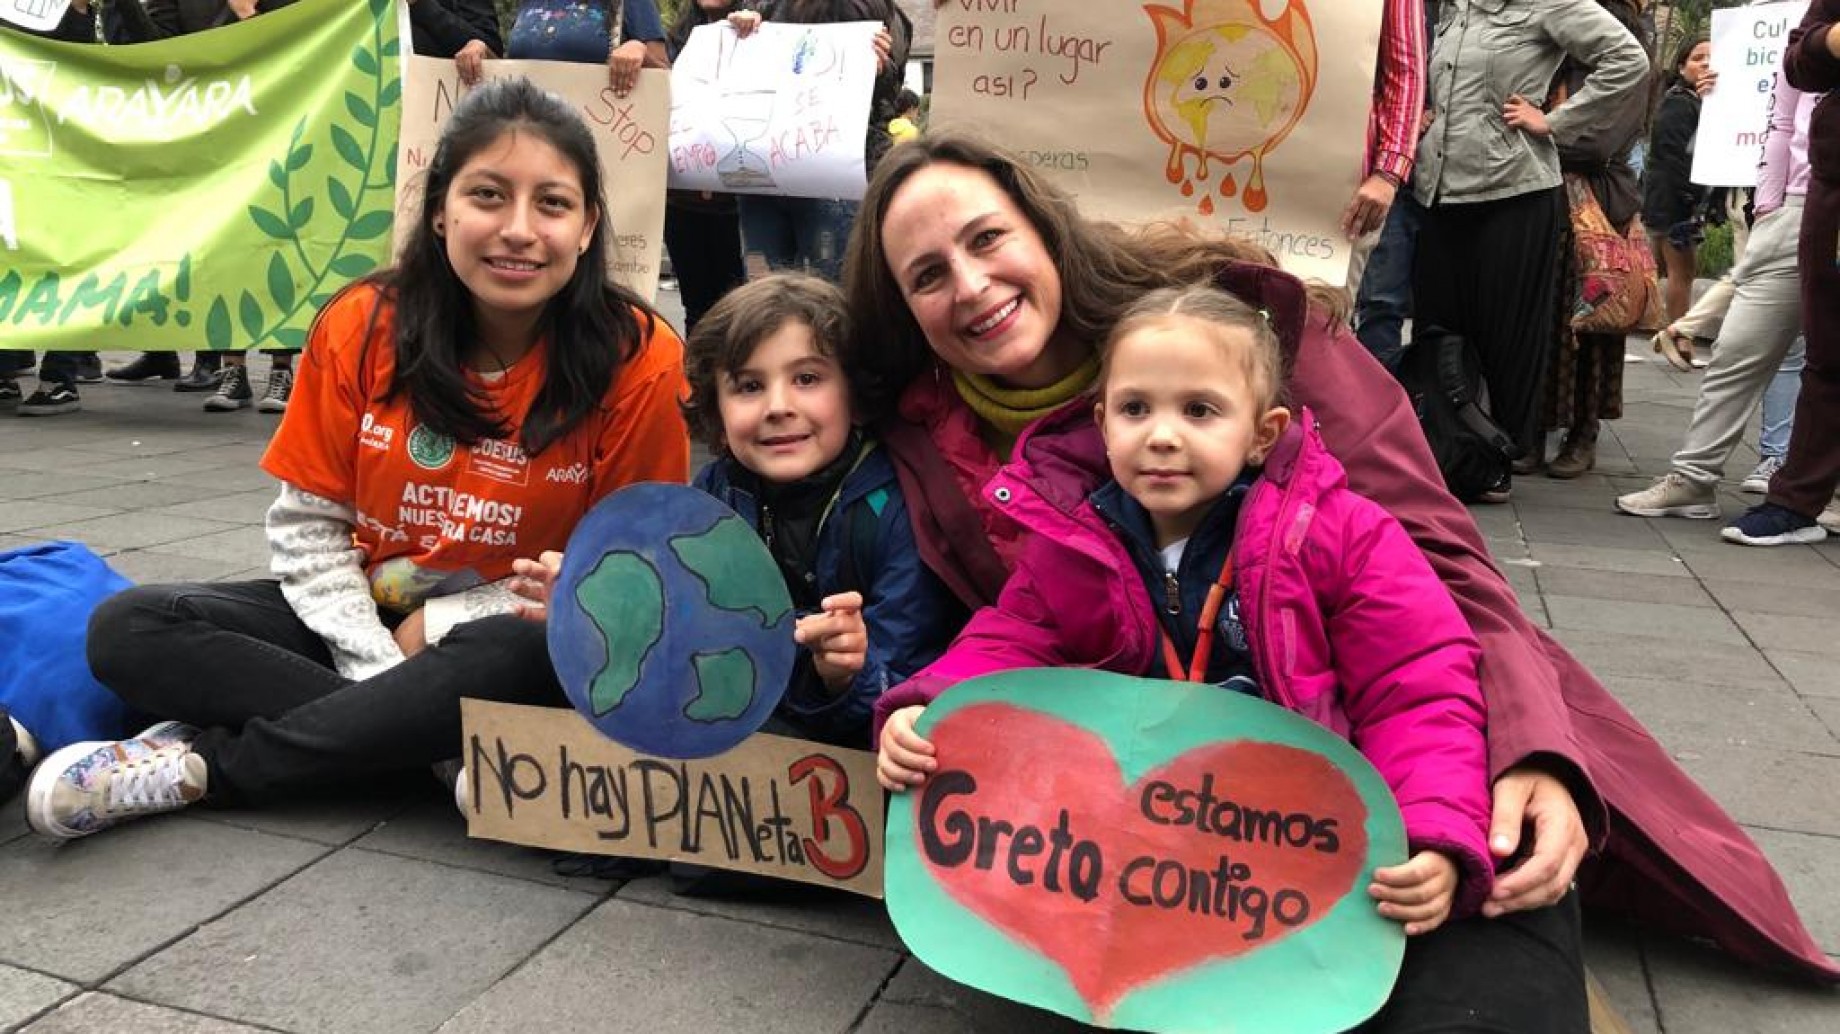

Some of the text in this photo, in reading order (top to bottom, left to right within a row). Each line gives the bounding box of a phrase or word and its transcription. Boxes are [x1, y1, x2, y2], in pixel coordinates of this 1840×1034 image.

[948, 14, 1112, 84] en un lugar
[58, 74, 258, 125] ARAYARA
[584, 86, 655, 160] Stop
[1228, 215, 1334, 260] Etonces
[398, 506, 517, 546] NUESRA CASA
[402, 481, 522, 528] ACTIEMOS!
[470, 734, 547, 819] No
[560, 745, 629, 839] hay
[788, 753, 870, 880] B
[1141, 774, 1340, 853] estamos
[1118, 855, 1310, 940] contigo
